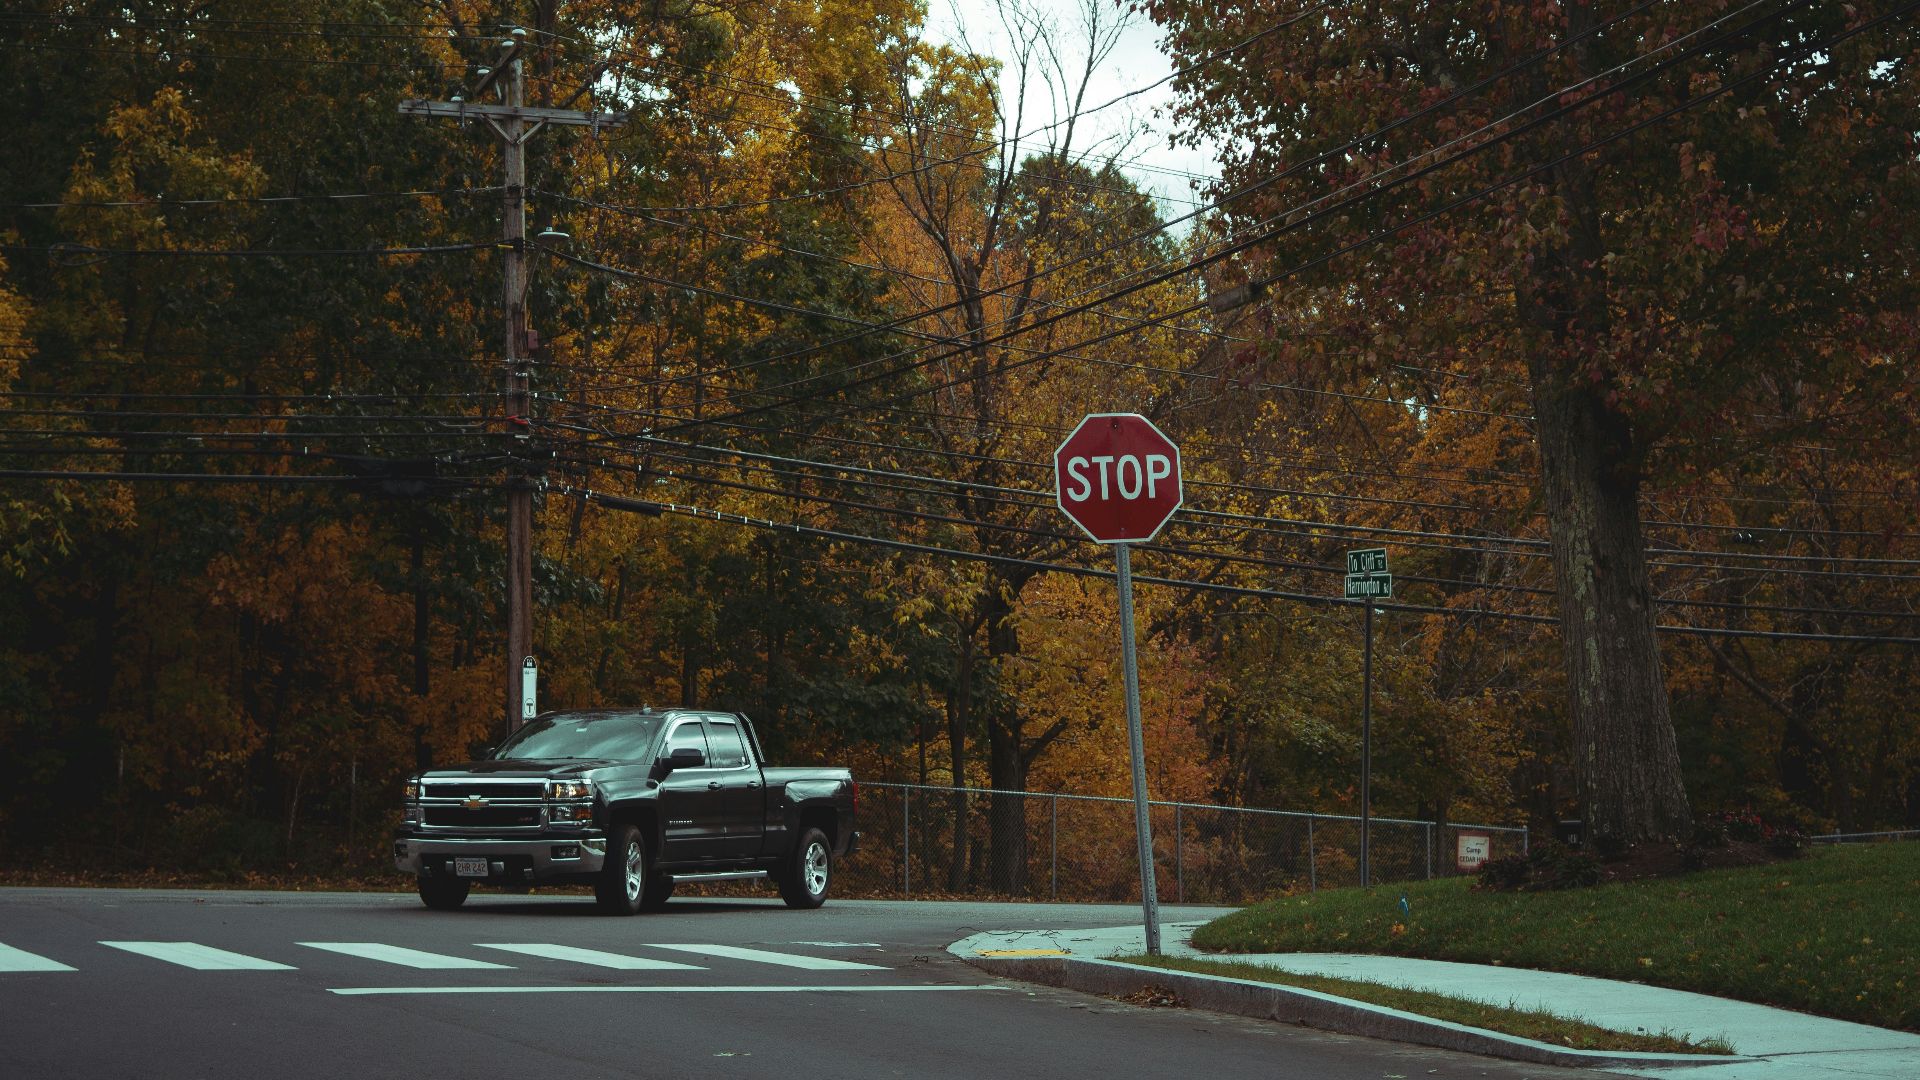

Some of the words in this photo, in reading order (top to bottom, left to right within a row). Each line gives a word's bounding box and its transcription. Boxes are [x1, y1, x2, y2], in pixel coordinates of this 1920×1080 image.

[1067, 454, 1171, 502] STOP
[1350, 554, 1358, 571] To
[1361, 552, 1375, 570] Cliff
[1347, 577, 1380, 597] Harrington
[1466, 846, 1481, 855] Camp
